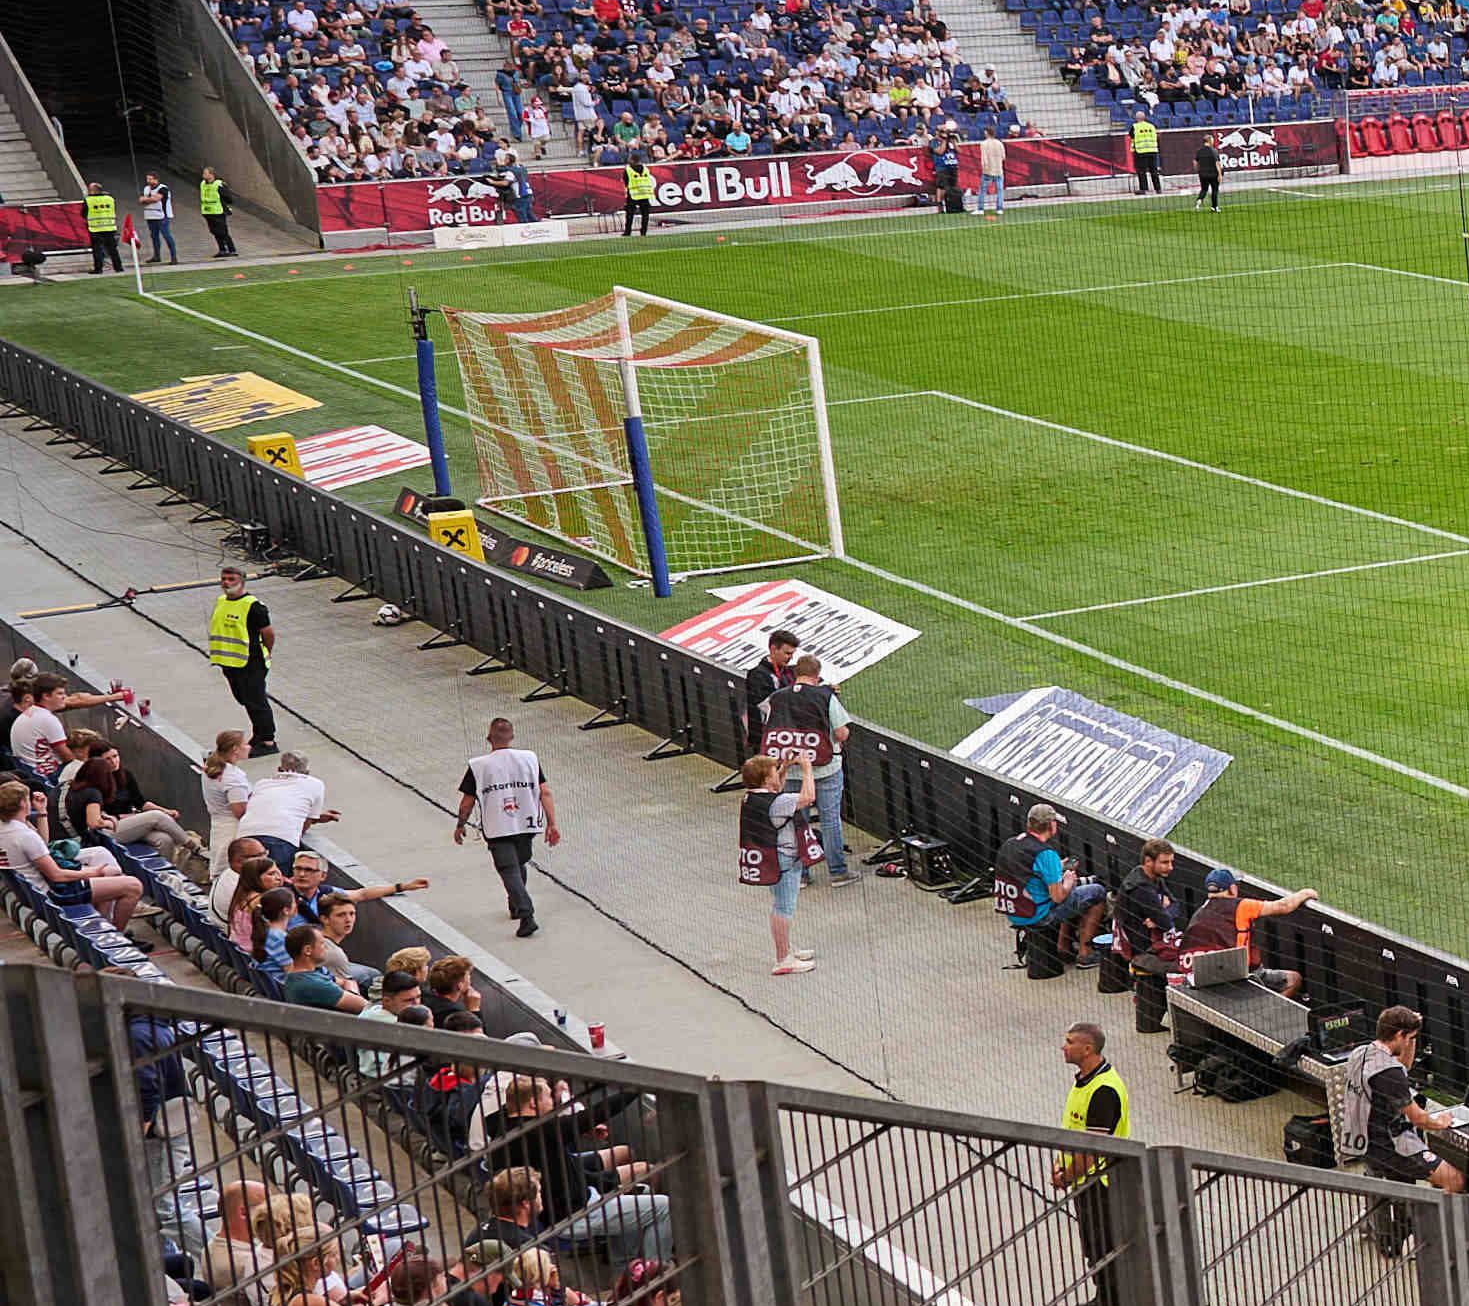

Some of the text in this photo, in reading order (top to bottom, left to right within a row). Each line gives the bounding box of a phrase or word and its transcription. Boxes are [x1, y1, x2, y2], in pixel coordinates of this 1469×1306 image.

[1219, 151, 1279, 168] Red Bull
[714, 159, 792, 202] Bull
[427, 206, 463, 227] Red
[765, 731, 820, 747] FOTO
[1343, 1133, 1366, 1150] 10
